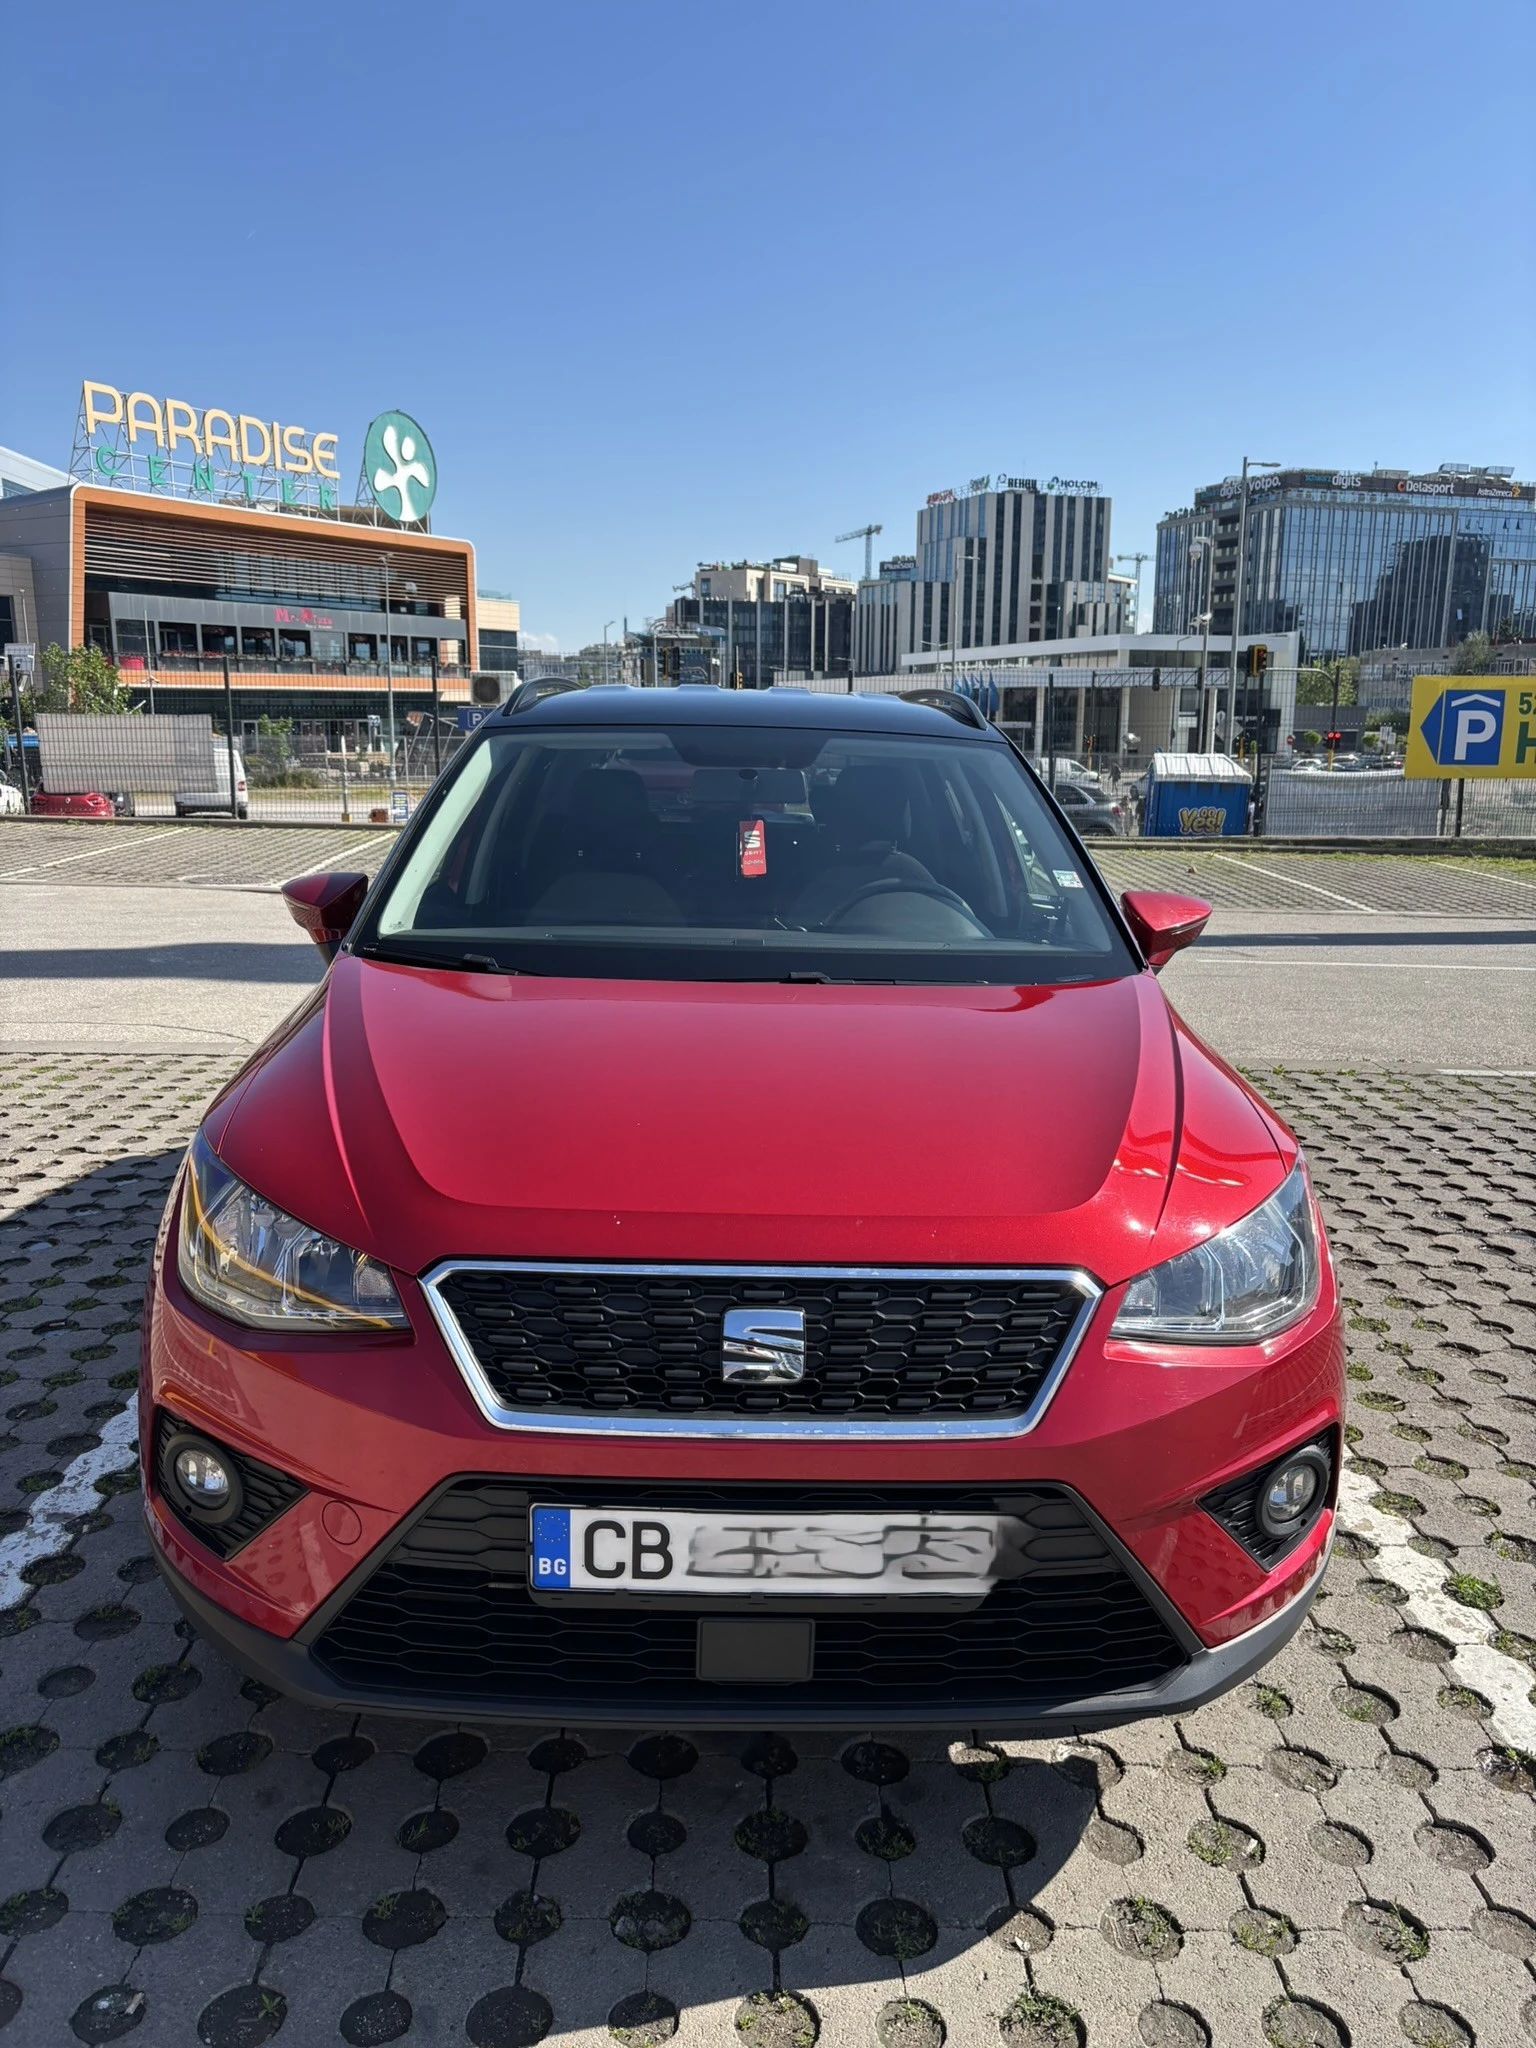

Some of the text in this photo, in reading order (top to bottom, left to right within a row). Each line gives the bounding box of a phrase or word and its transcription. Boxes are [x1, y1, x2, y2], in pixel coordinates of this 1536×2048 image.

[83, 380, 340, 480] PARADISE
[96, 446, 334, 511] CENTER
[1060, 480, 1098, 489] HOLCIM
[1332, 472, 1362, 489] digits
[1219, 482, 1242, 499] digits
[1406, 481, 1455, 496] Delasport
[1477, 487, 1513, 498] AstraZeneca
[1518, 692, 1536, 715] 5
[472, 713, 482, 726] P
[1453, 709, 1497, 761] P
[584, 1519, 674, 1580] CB
[538, 1557, 567, 1575] BG
